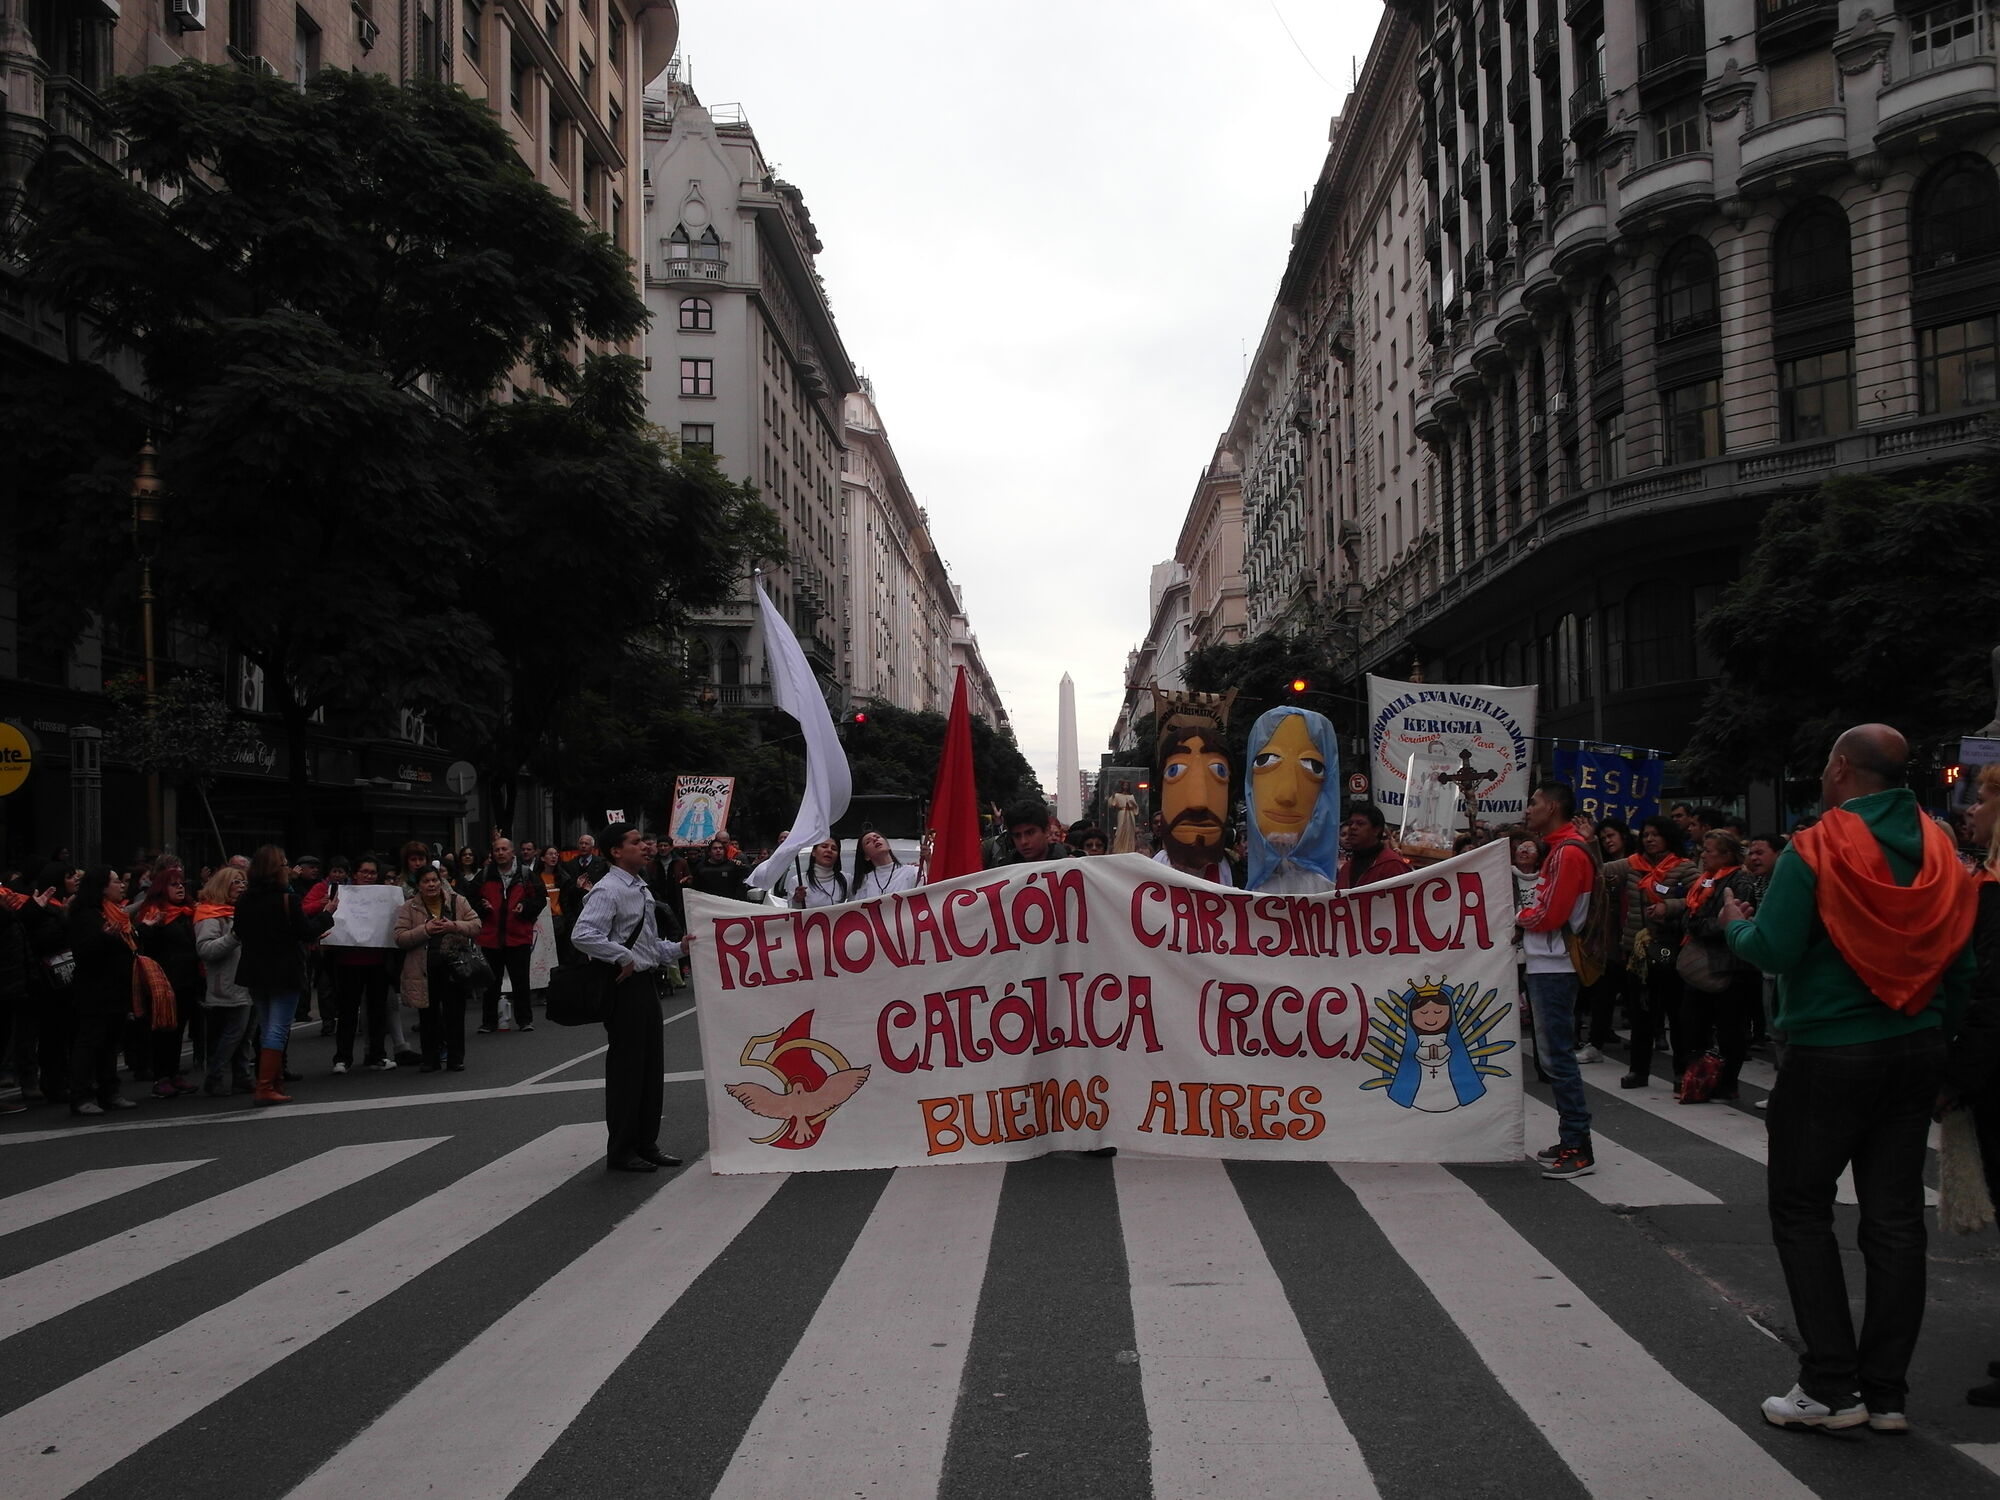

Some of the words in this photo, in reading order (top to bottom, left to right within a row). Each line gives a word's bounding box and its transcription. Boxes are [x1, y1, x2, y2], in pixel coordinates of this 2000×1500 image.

[1403, 717, 1482, 734] KERIGMA
[1471, 735, 1496, 749] Para
[1497, 746, 1511, 760] La
[717, 783, 730, 796] de
[1457, 799, 1522, 813] KINONIA
[712, 868, 1090, 991] RENOVACIÓN
[1130, 872, 1494, 958] CARISMÁTICA
[876, 971, 1164, 1074] CATÓLICA
[1199, 978, 1370, 1062] (R.C.C.)
[917, 1074, 1110, 1158] BUENOS
[1137, 1080, 1327, 1141] AIRES
